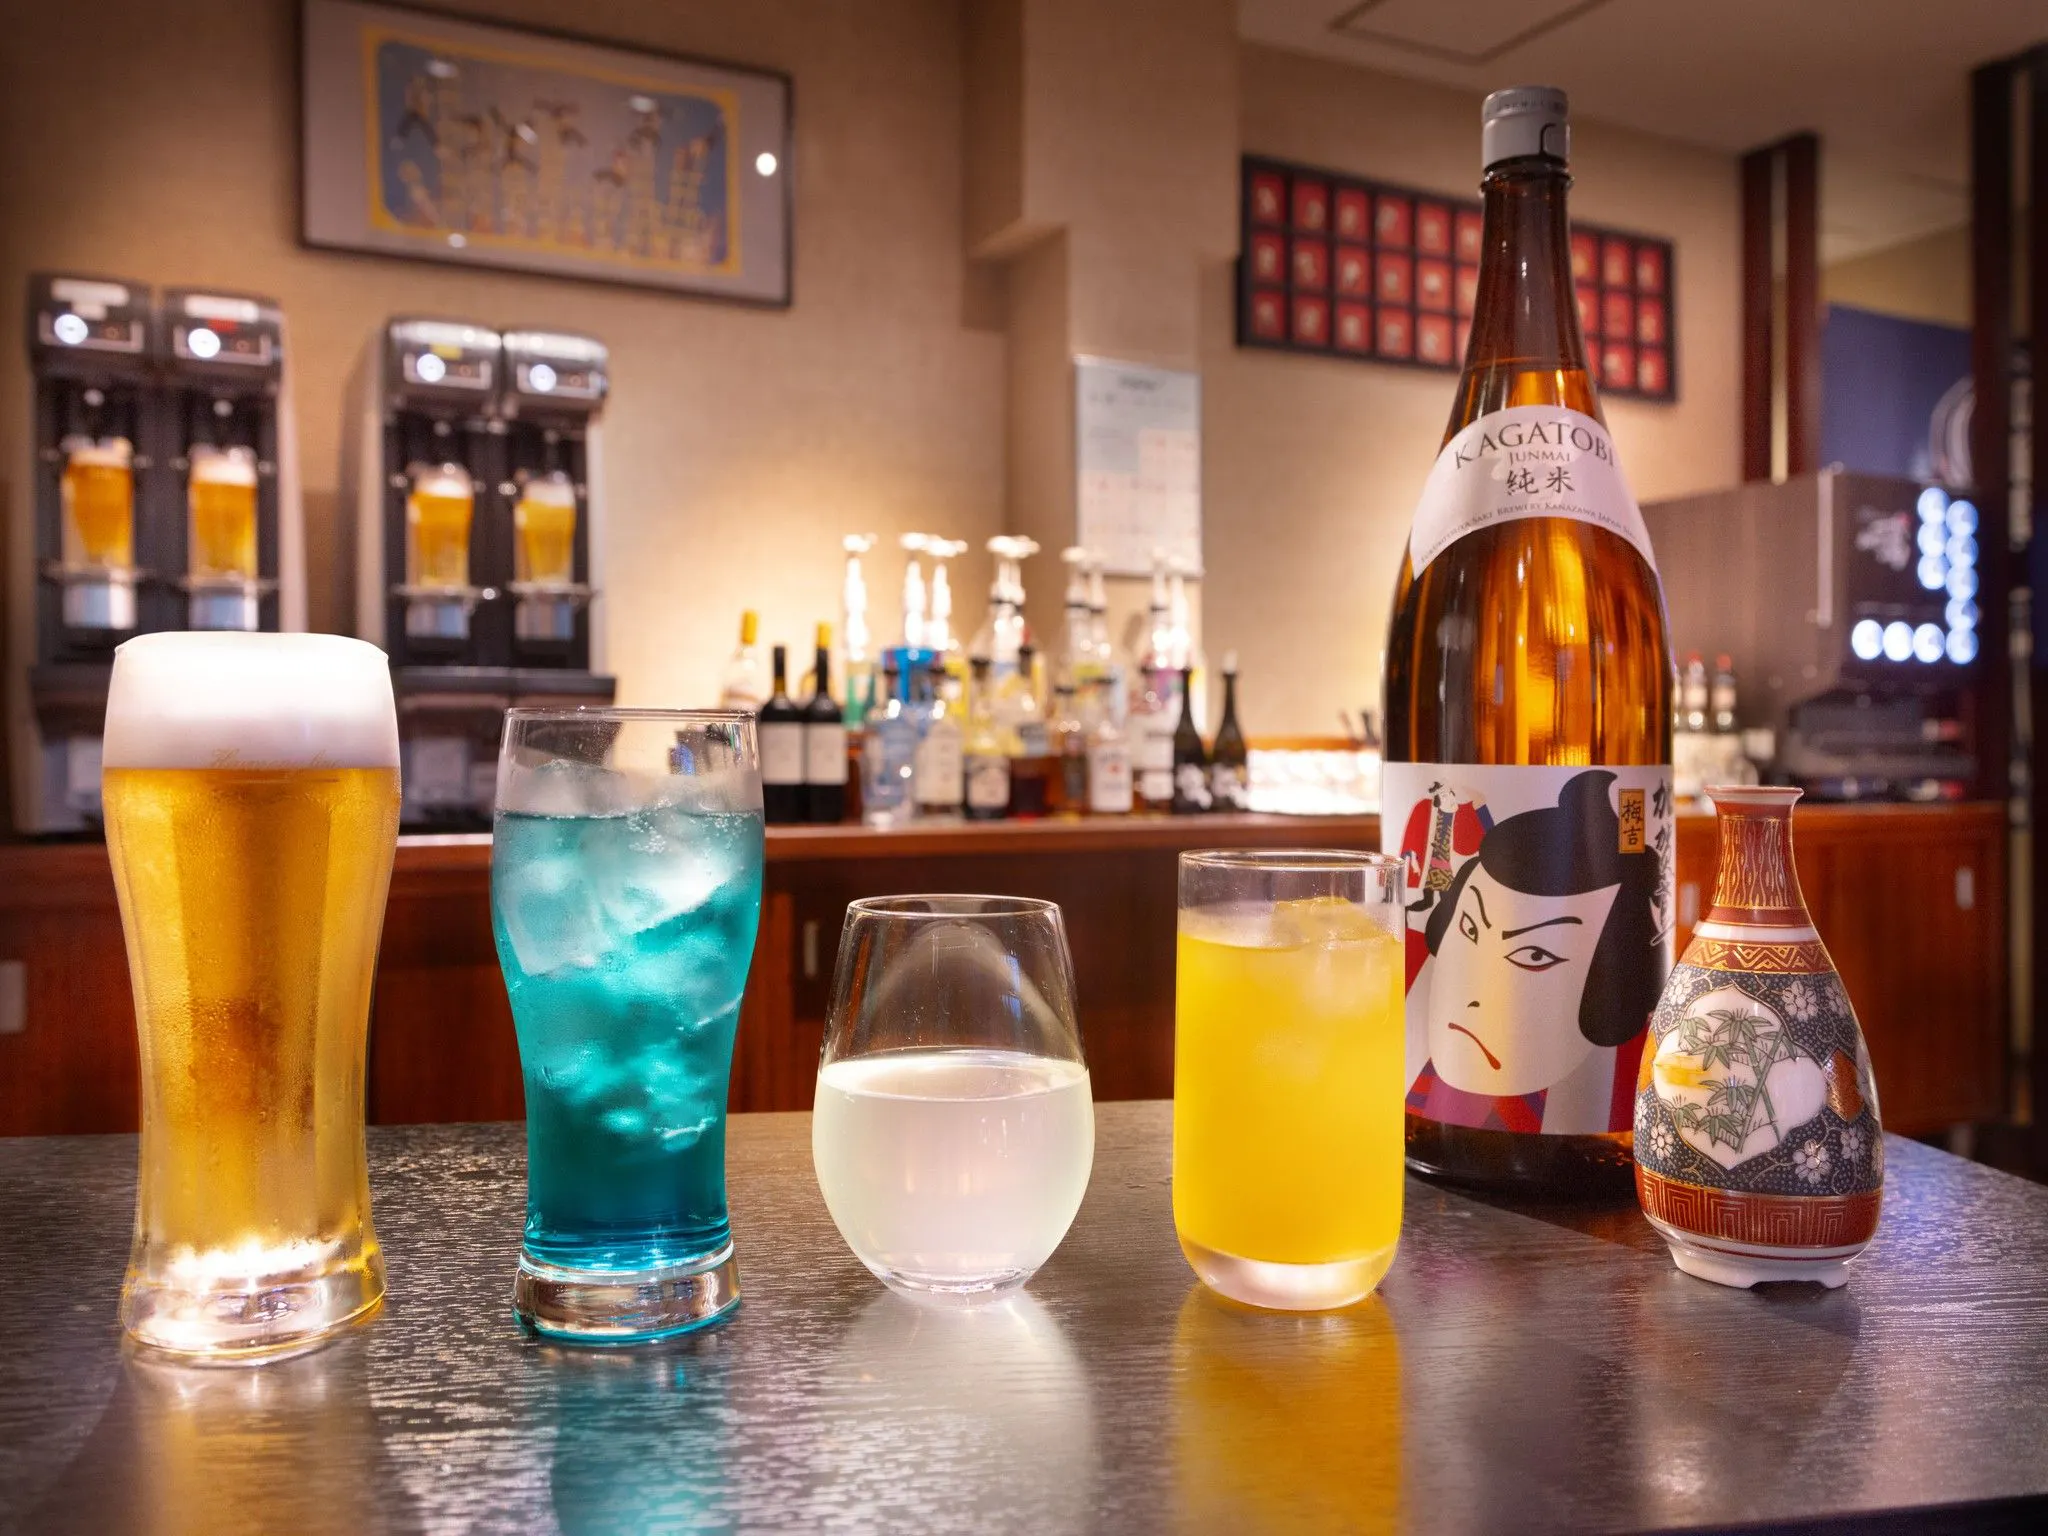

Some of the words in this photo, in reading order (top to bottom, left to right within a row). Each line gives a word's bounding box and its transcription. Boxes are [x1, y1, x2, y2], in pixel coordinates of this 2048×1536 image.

[1454, 421, 1615, 470] KAGATOBI
[1508, 450, 1572, 465] JUNMAI
[1505, 465, 1576, 496] 純米
[1620, 798, 1645, 846] 梅吉
